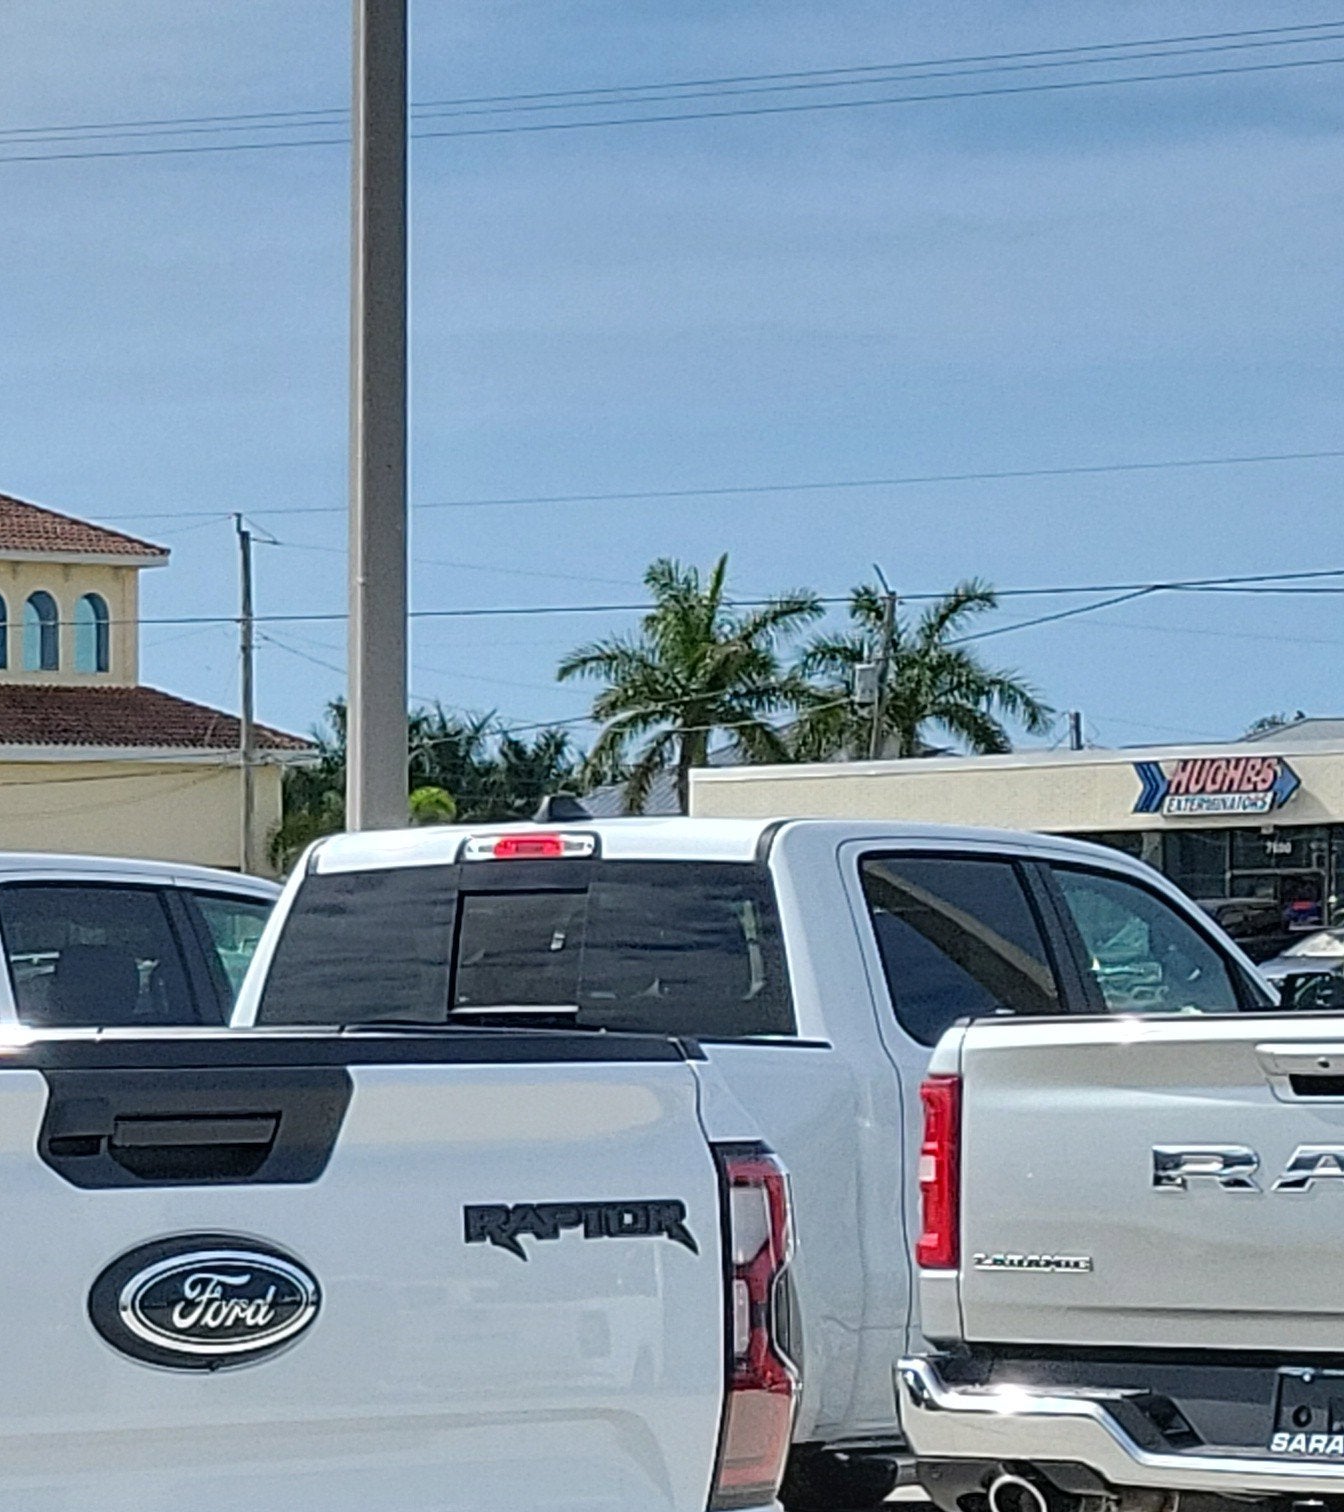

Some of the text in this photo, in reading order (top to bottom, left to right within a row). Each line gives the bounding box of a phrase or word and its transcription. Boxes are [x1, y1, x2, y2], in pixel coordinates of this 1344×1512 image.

[1169, 757, 1278, 794] HUGHES
[463, 1199, 700, 1262] RAPTOR
[171, 1272, 275, 1329] Ford
